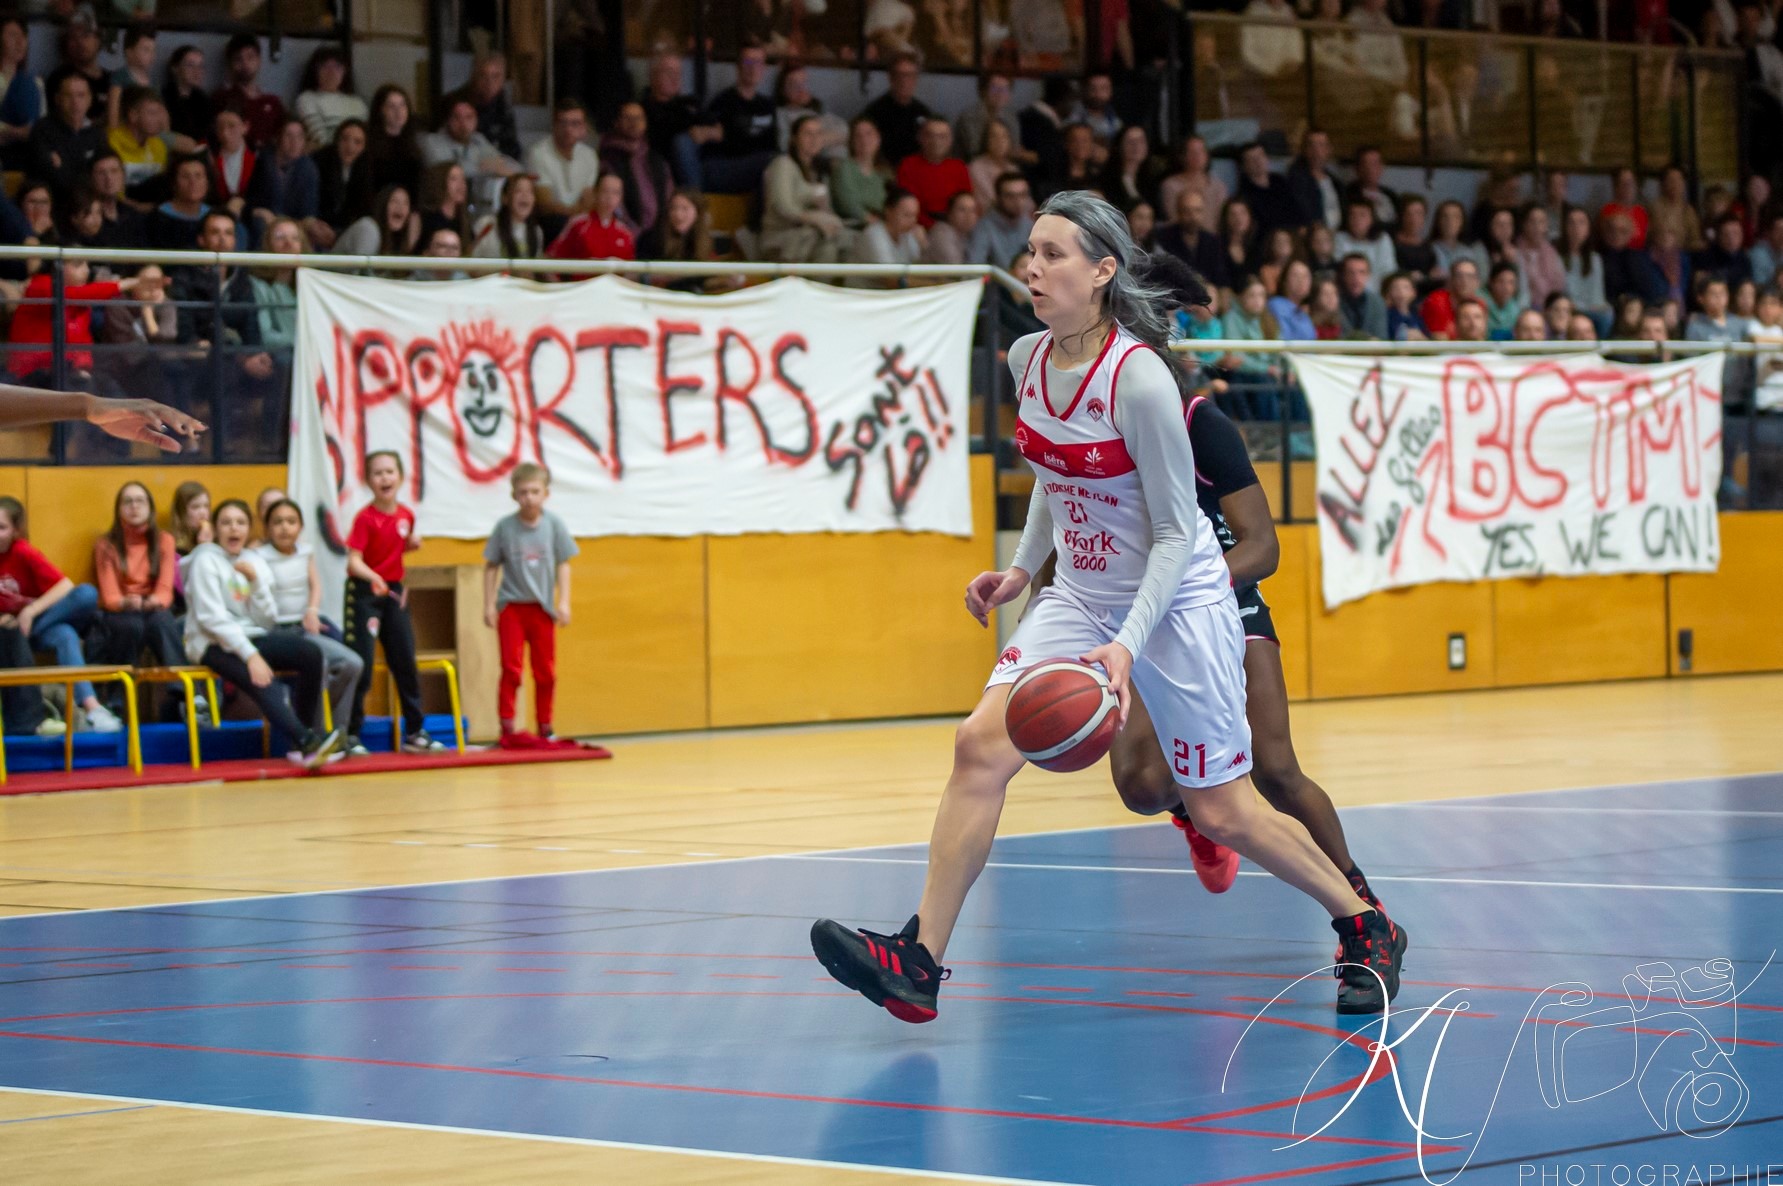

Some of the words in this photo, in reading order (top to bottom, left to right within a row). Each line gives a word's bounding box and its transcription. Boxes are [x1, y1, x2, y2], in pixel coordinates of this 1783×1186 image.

[1317, 362, 1408, 552] ALLEZ
[1444, 359, 1700, 520] BCTM
[1063, 528, 1121, 556] Work
[1072, 553, 1107, 572] 2000
[1559, 511, 1622, 570] WE
[1173, 737, 1206, 778] 21
